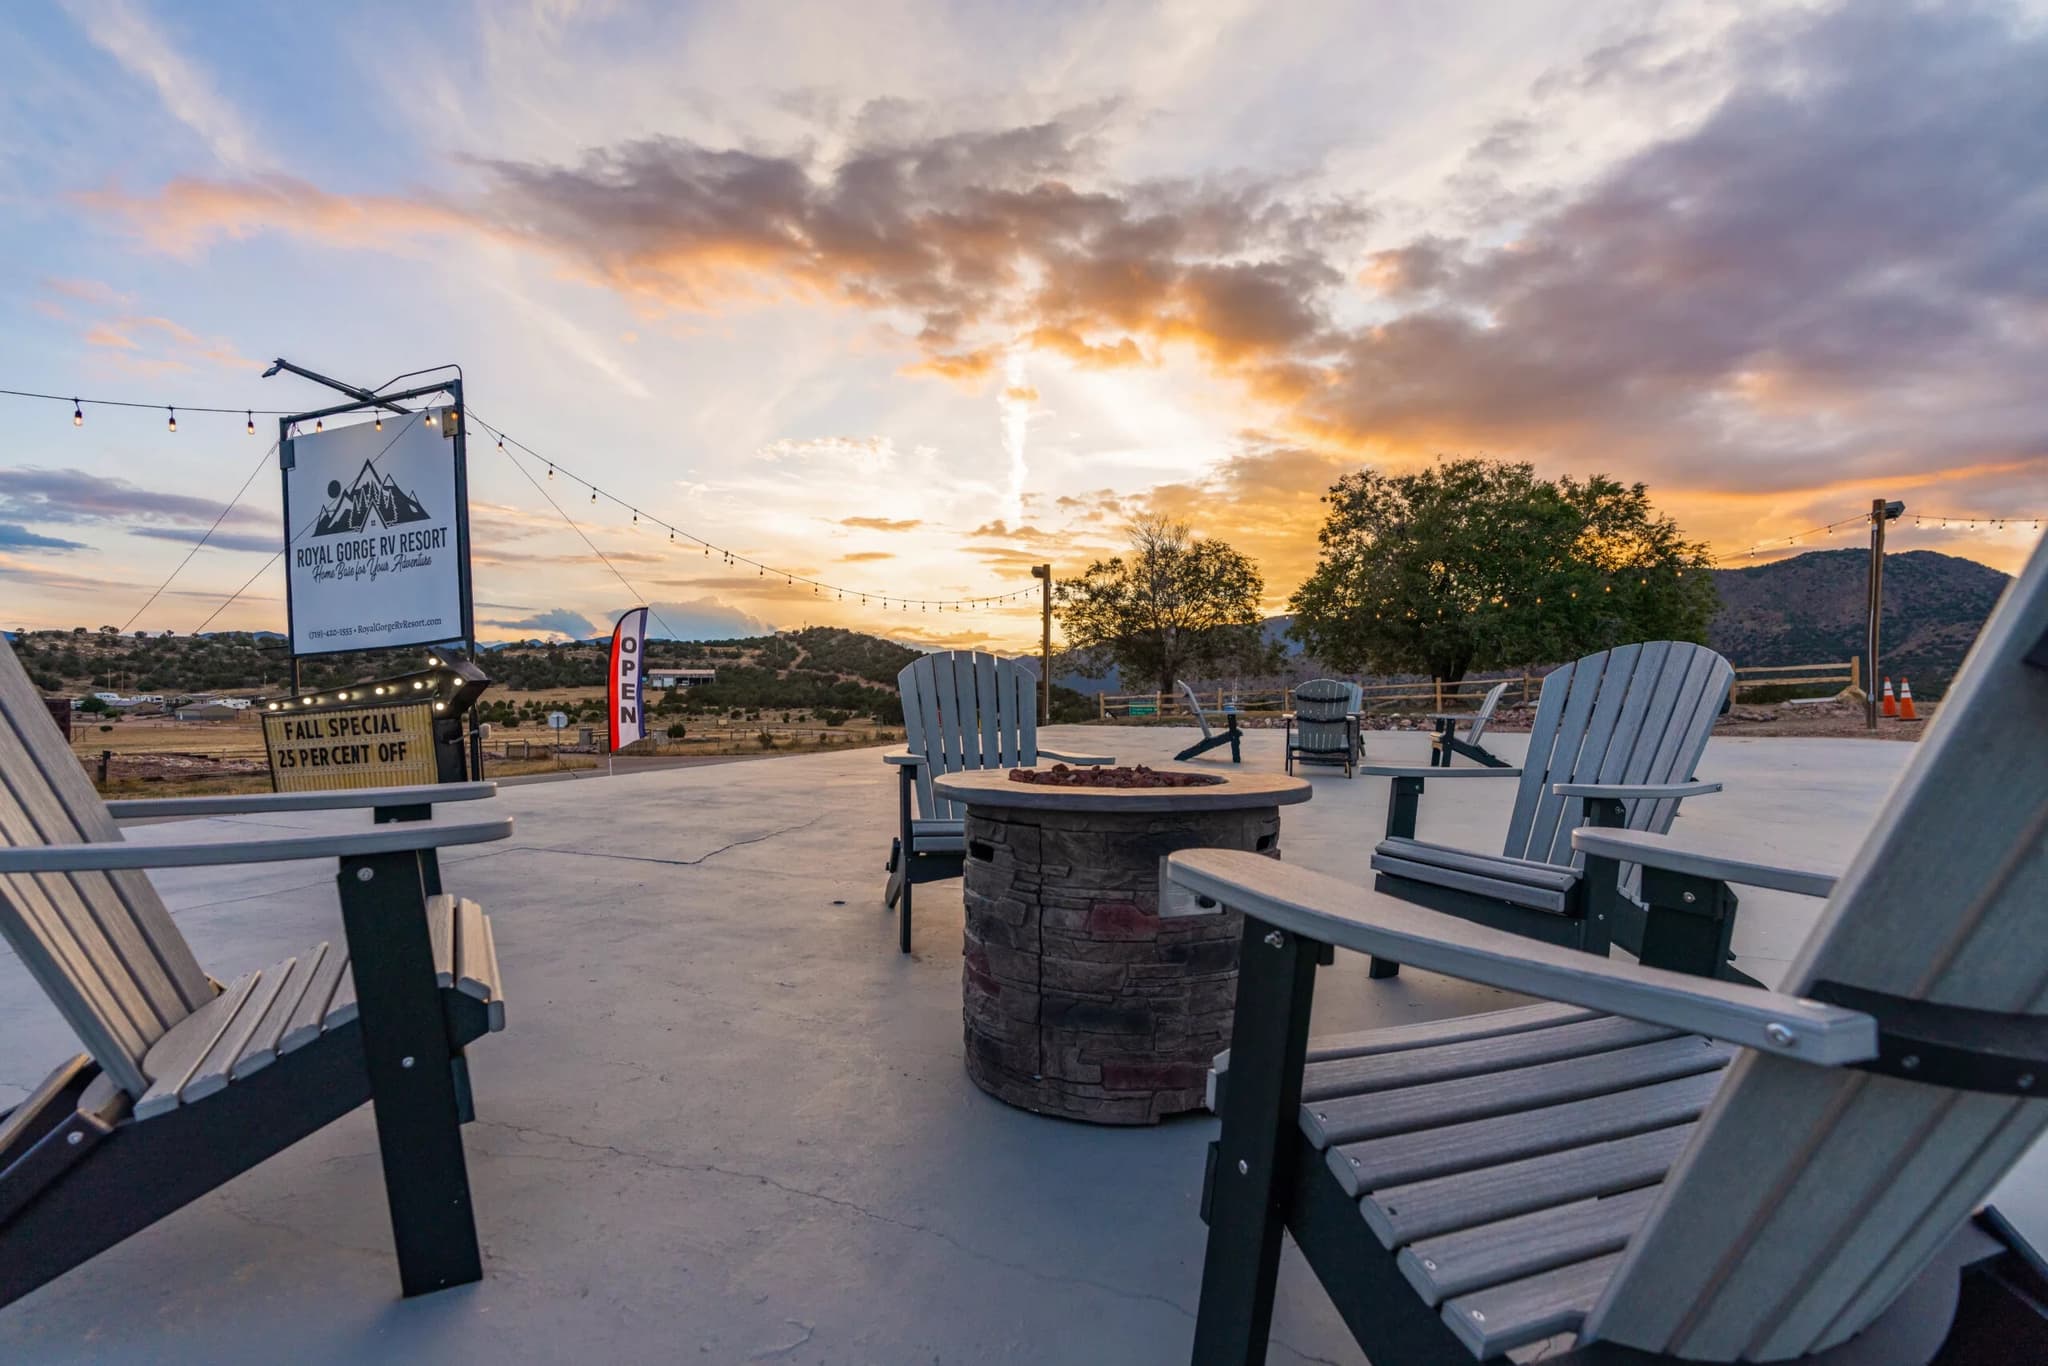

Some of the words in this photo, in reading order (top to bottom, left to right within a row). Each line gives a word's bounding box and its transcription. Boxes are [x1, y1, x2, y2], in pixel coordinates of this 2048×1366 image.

[297, 547, 334, 568] ROYAL
[336, 538, 377, 562] GORGE
[380, 538, 397, 556] RV
[399, 527, 448, 553] RESORT
[312, 565, 335, 583] Home
[335, 562, 354, 580] Base
[355, 561, 367, 581] for
[367, 557, 389, 582] Your
[391, 552, 432, 572] Adventure
[357, 618, 442, 635] RoyalGorgeRvResort.com
[621, 636, 637, 713] OPEN
[285, 719, 324, 740] FALL
[328, 713, 401, 737] SPECIAL
[278, 749, 295, 768] 25
[378, 741, 407, 762] OFF
